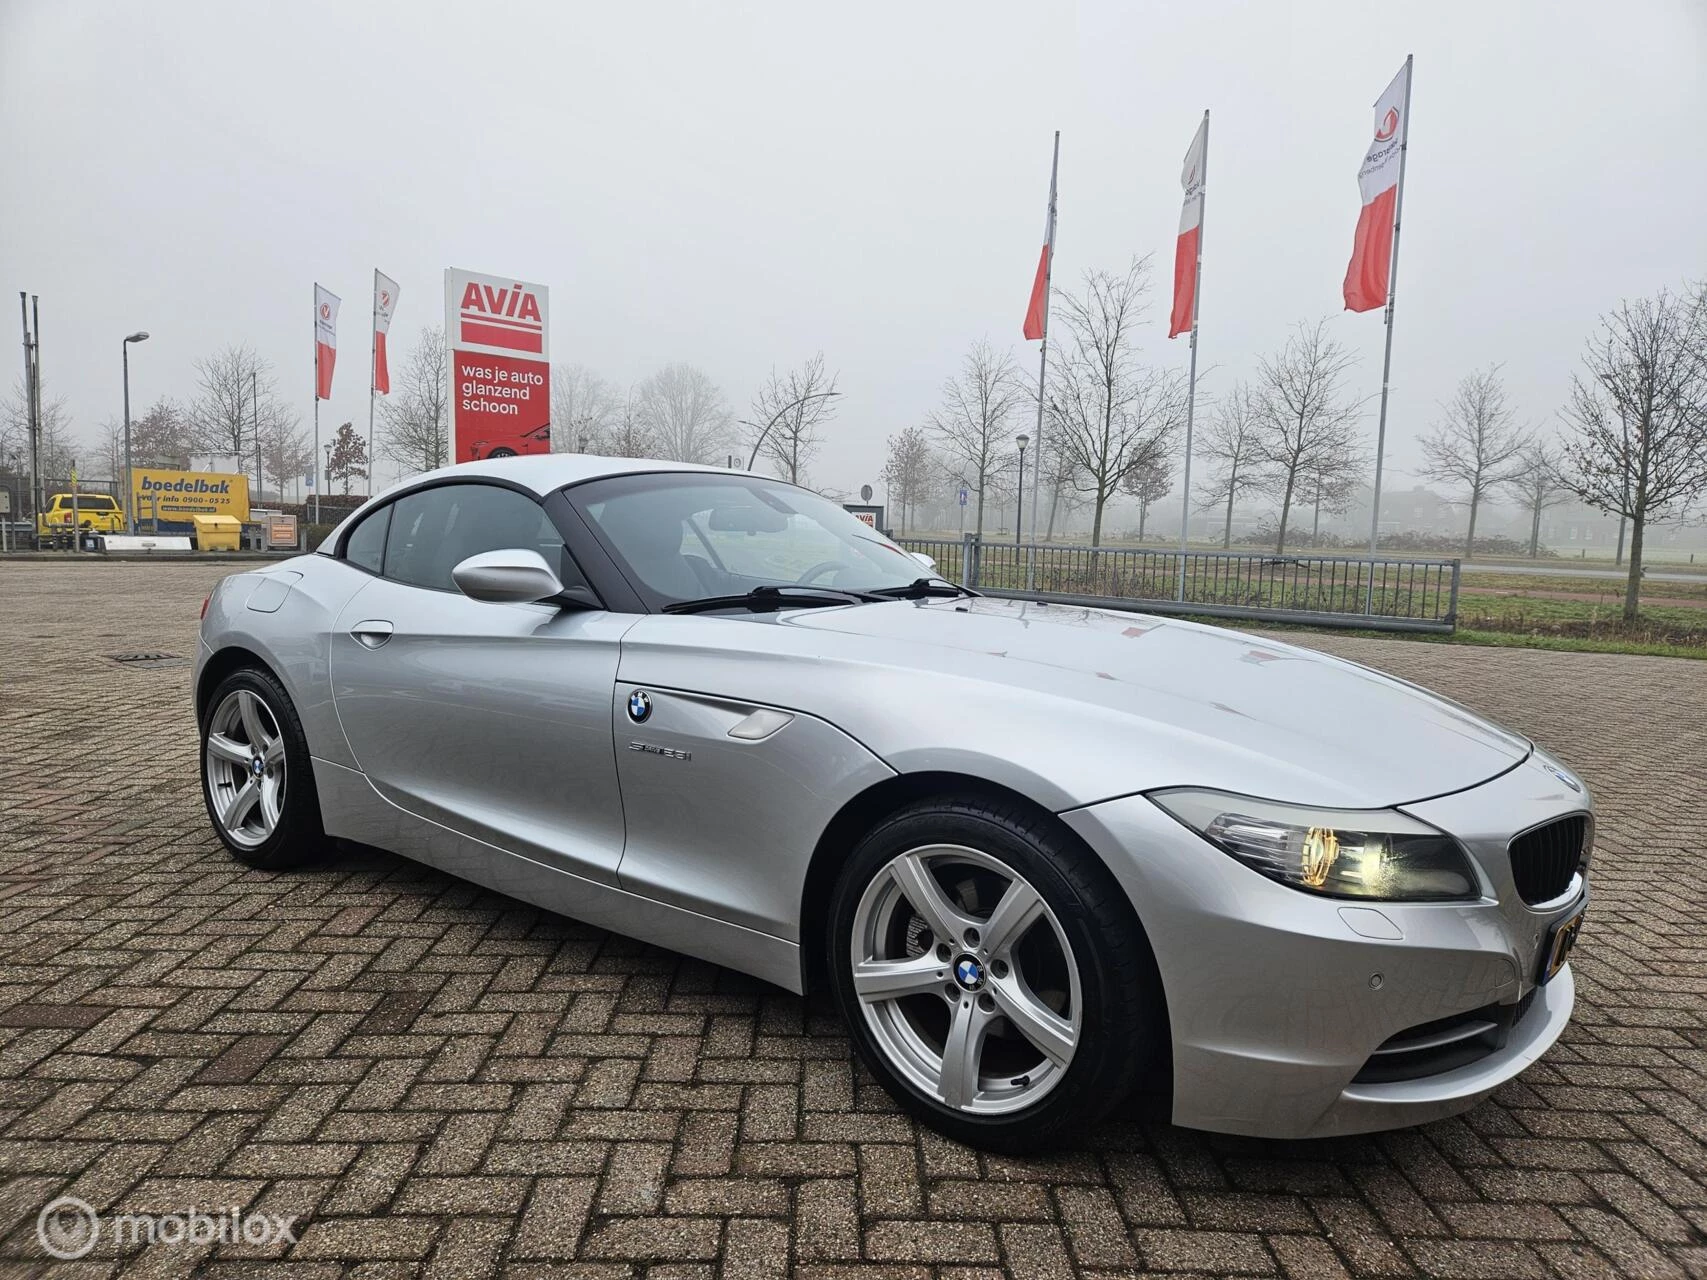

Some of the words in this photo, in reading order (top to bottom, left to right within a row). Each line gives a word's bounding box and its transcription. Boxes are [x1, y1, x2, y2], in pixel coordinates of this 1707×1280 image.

[461, 364, 492, 380] was
[493, 366, 508, 384] je
[511, 372, 544, 386] auto
[462, 379, 530, 401] glanzend
[462, 397, 519, 415] schoon
[141, 475, 230, 494] boedelbak
[142, 494, 161, 502] vor
[163, 495, 180, 503] info
